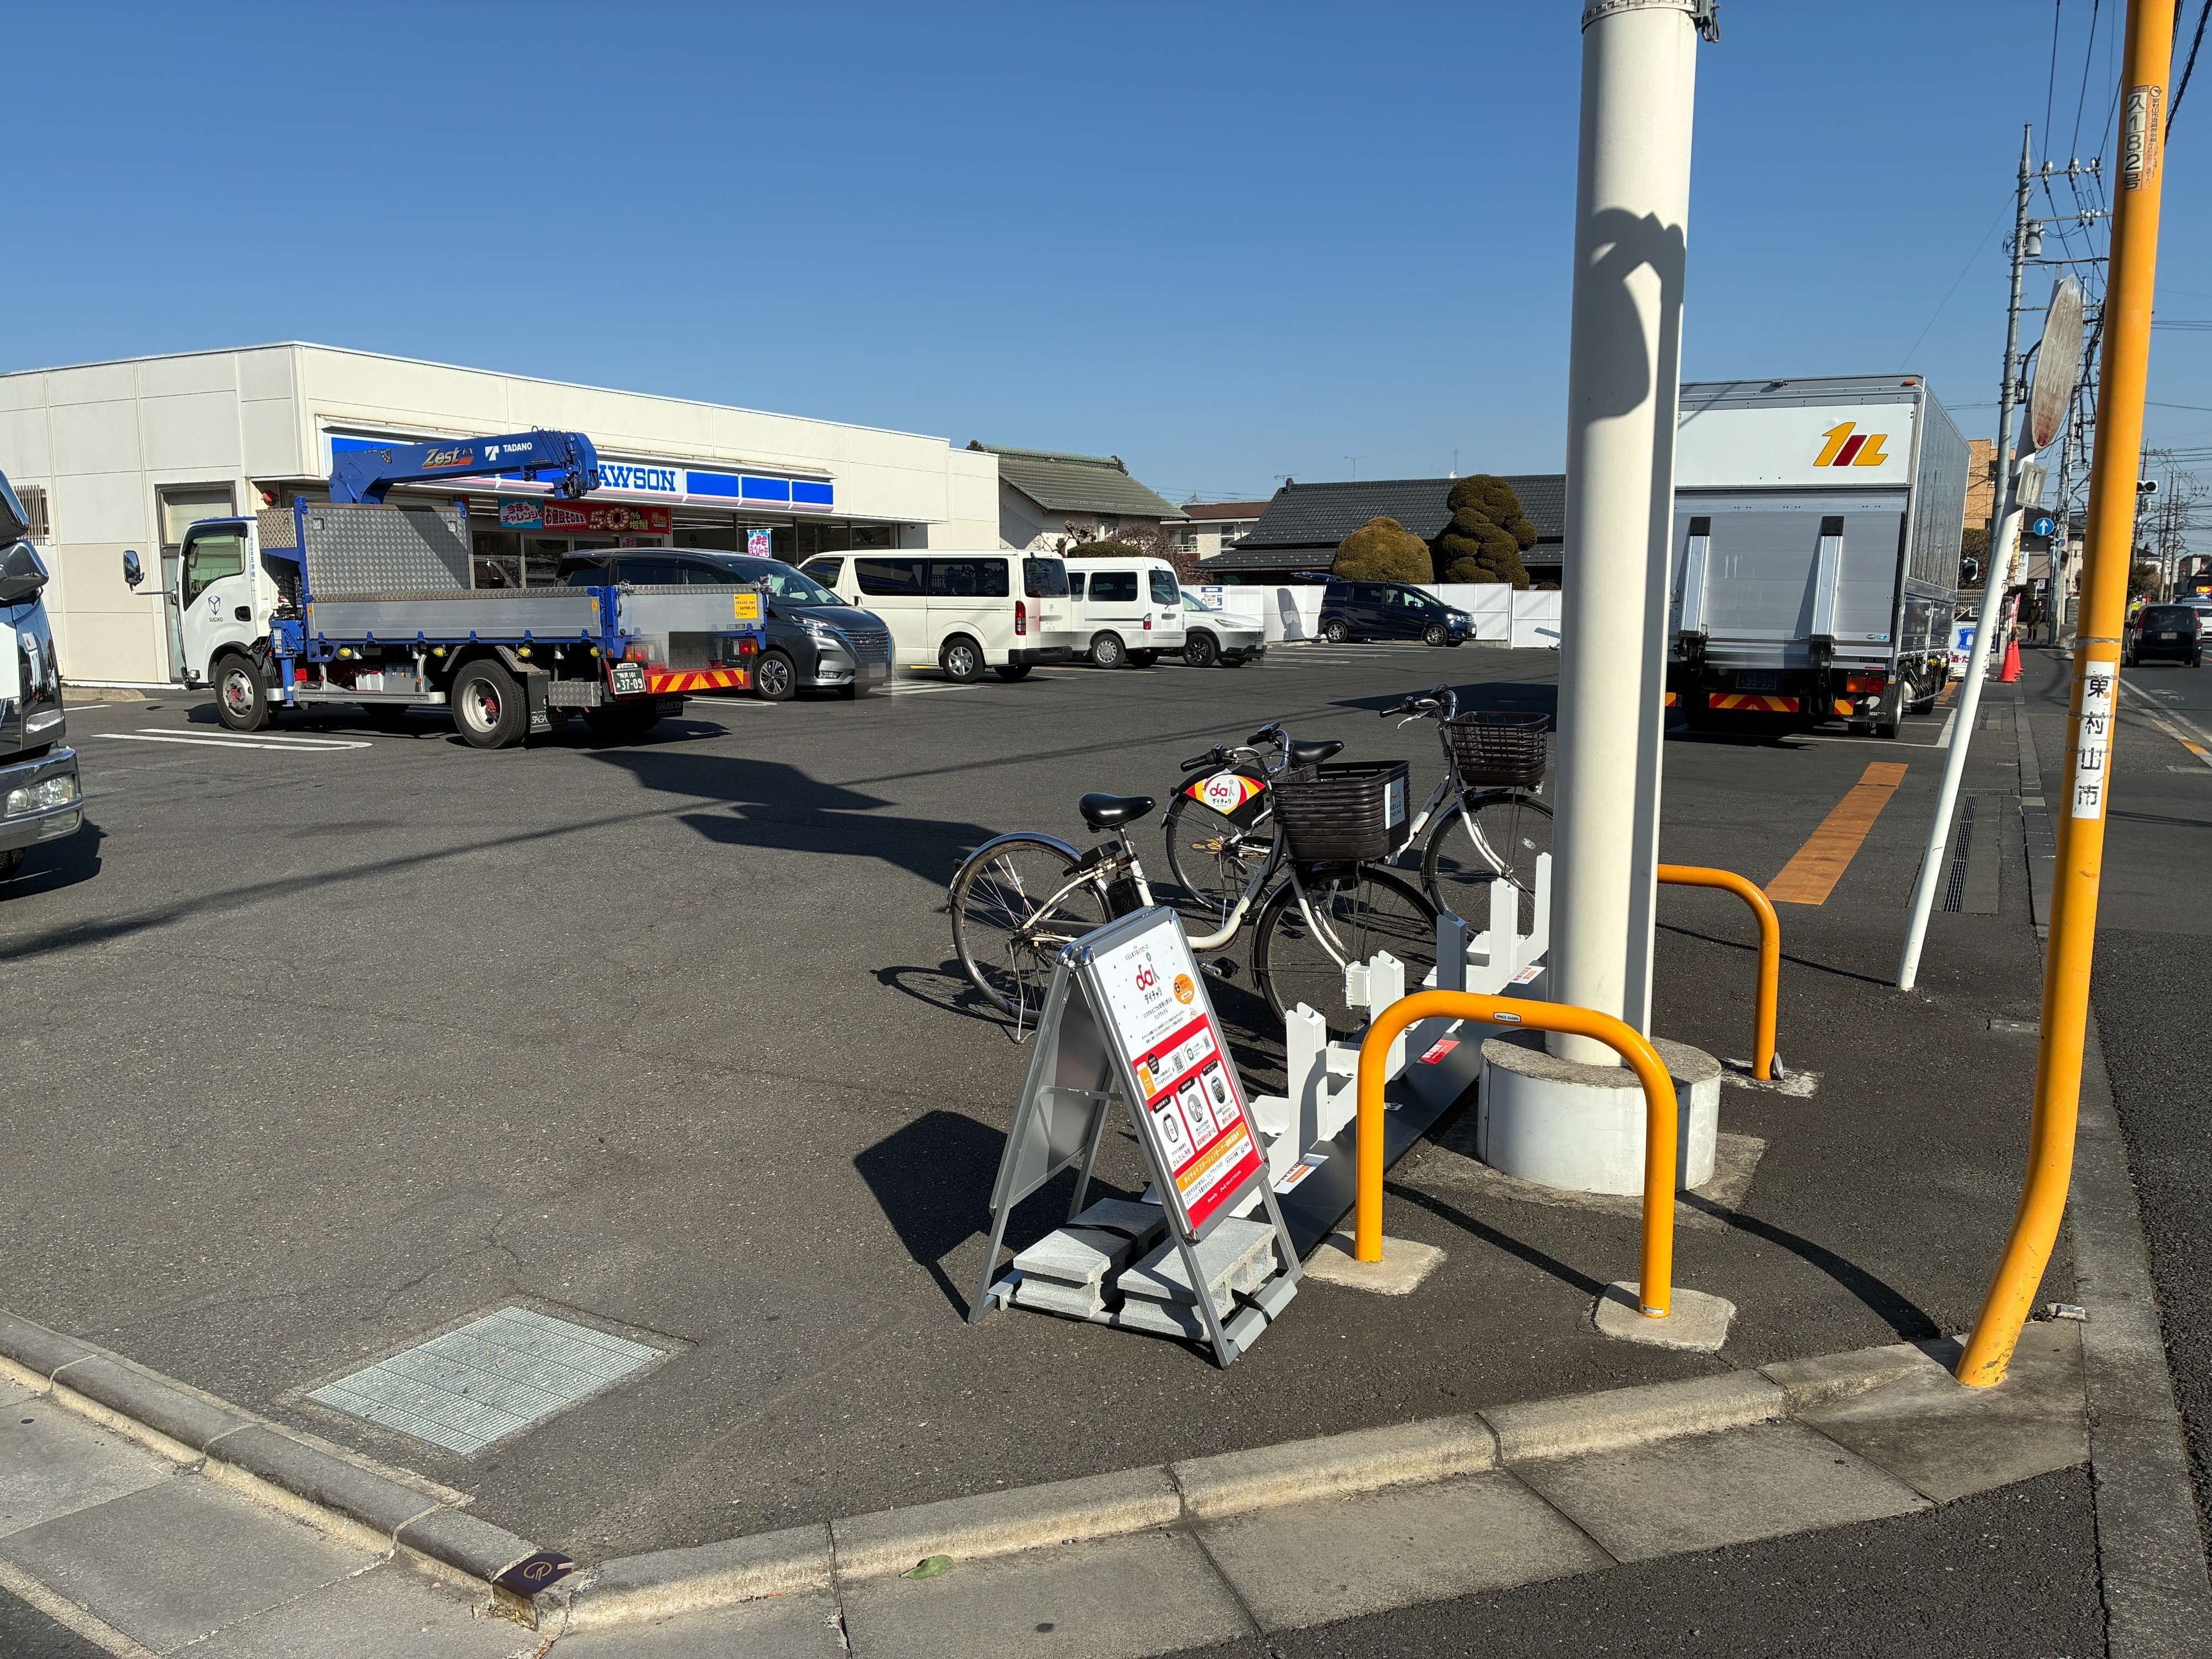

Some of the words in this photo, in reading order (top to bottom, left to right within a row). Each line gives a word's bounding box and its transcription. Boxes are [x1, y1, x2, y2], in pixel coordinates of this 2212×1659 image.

[503, 442, 533, 453] TADANO
[422, 447, 461, 467] Zest
[599, 465, 676, 492] AWSON
[506, 504, 530, 513] 今年も
[545, 507, 585, 525] お値段そのまま
[629, 519, 649, 530] 増量
[1951, 654, 1970, 663] 酒・た
[620, 678, 643, 690] 37-09
[2078, 677, 2108, 806] 東村山市
[1210, 779, 1235, 797] dai
[1136, 953, 1159, 991] dai
[1144, 987, 1162, 1004] ダイチャリ
[1173, 1148, 1191, 1167] かんたん予約
